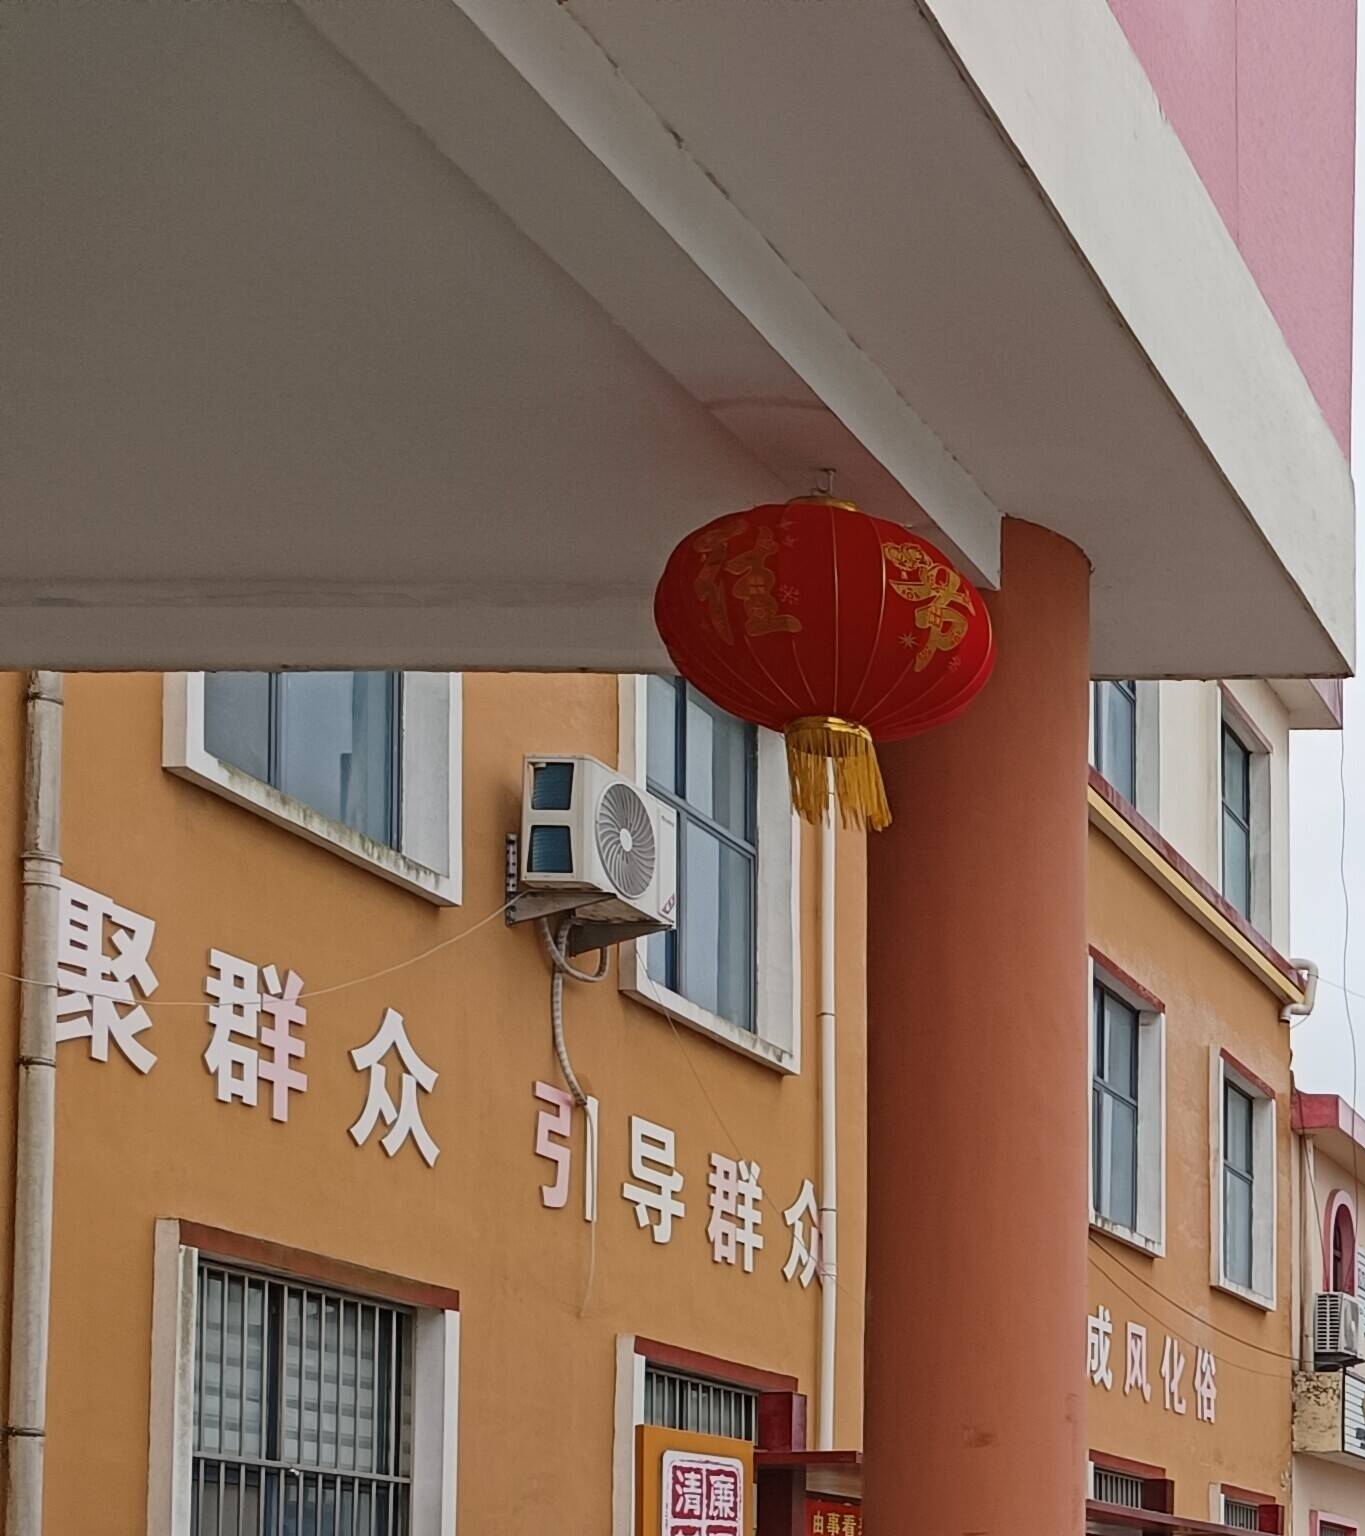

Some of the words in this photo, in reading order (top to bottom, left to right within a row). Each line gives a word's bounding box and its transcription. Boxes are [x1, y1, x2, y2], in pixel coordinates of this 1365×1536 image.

[56, 875, 440, 1168] 聚群众
[534, 1080, 824, 1288] 引导群众
[1087, 1304, 1217, 1424] 成风化俗
